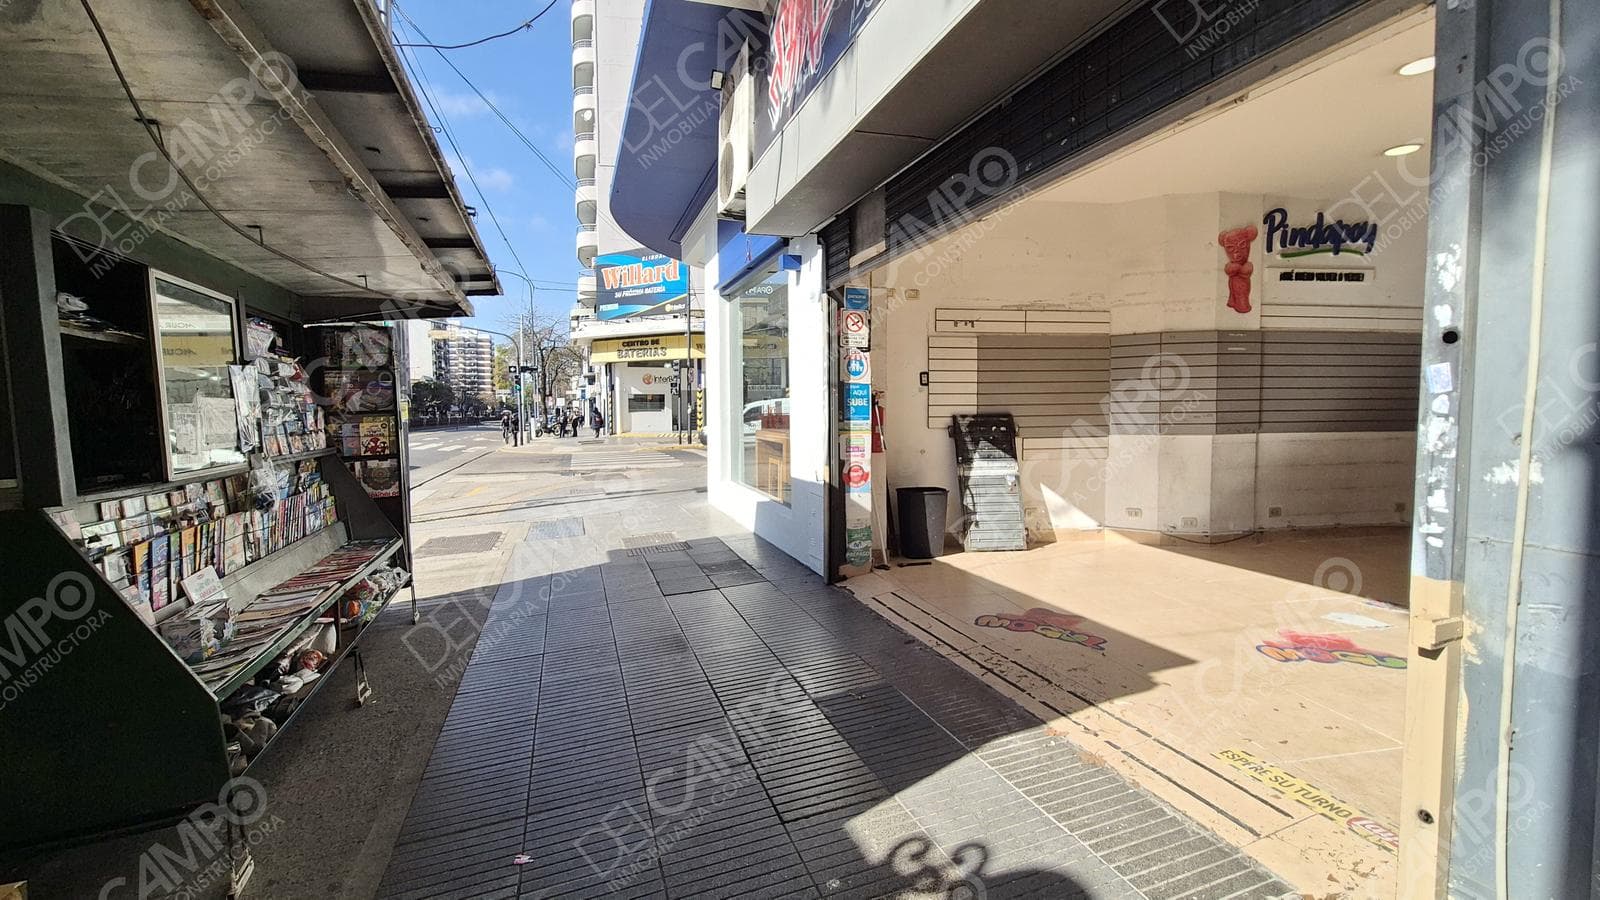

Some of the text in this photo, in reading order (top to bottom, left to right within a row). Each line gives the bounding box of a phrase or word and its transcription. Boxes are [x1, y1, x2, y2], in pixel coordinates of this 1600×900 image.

[1263, 207, 1377, 256] Pindapoy
[601, 259, 680, 289] Willard
[617, 347, 667, 358] BATERIAS
[622, 339, 650, 347] CENTRO
[848, 398, 869, 406] SUBE
[1268, 772, 1296, 788] SU
[1294, 786, 1353, 818] TURNO
